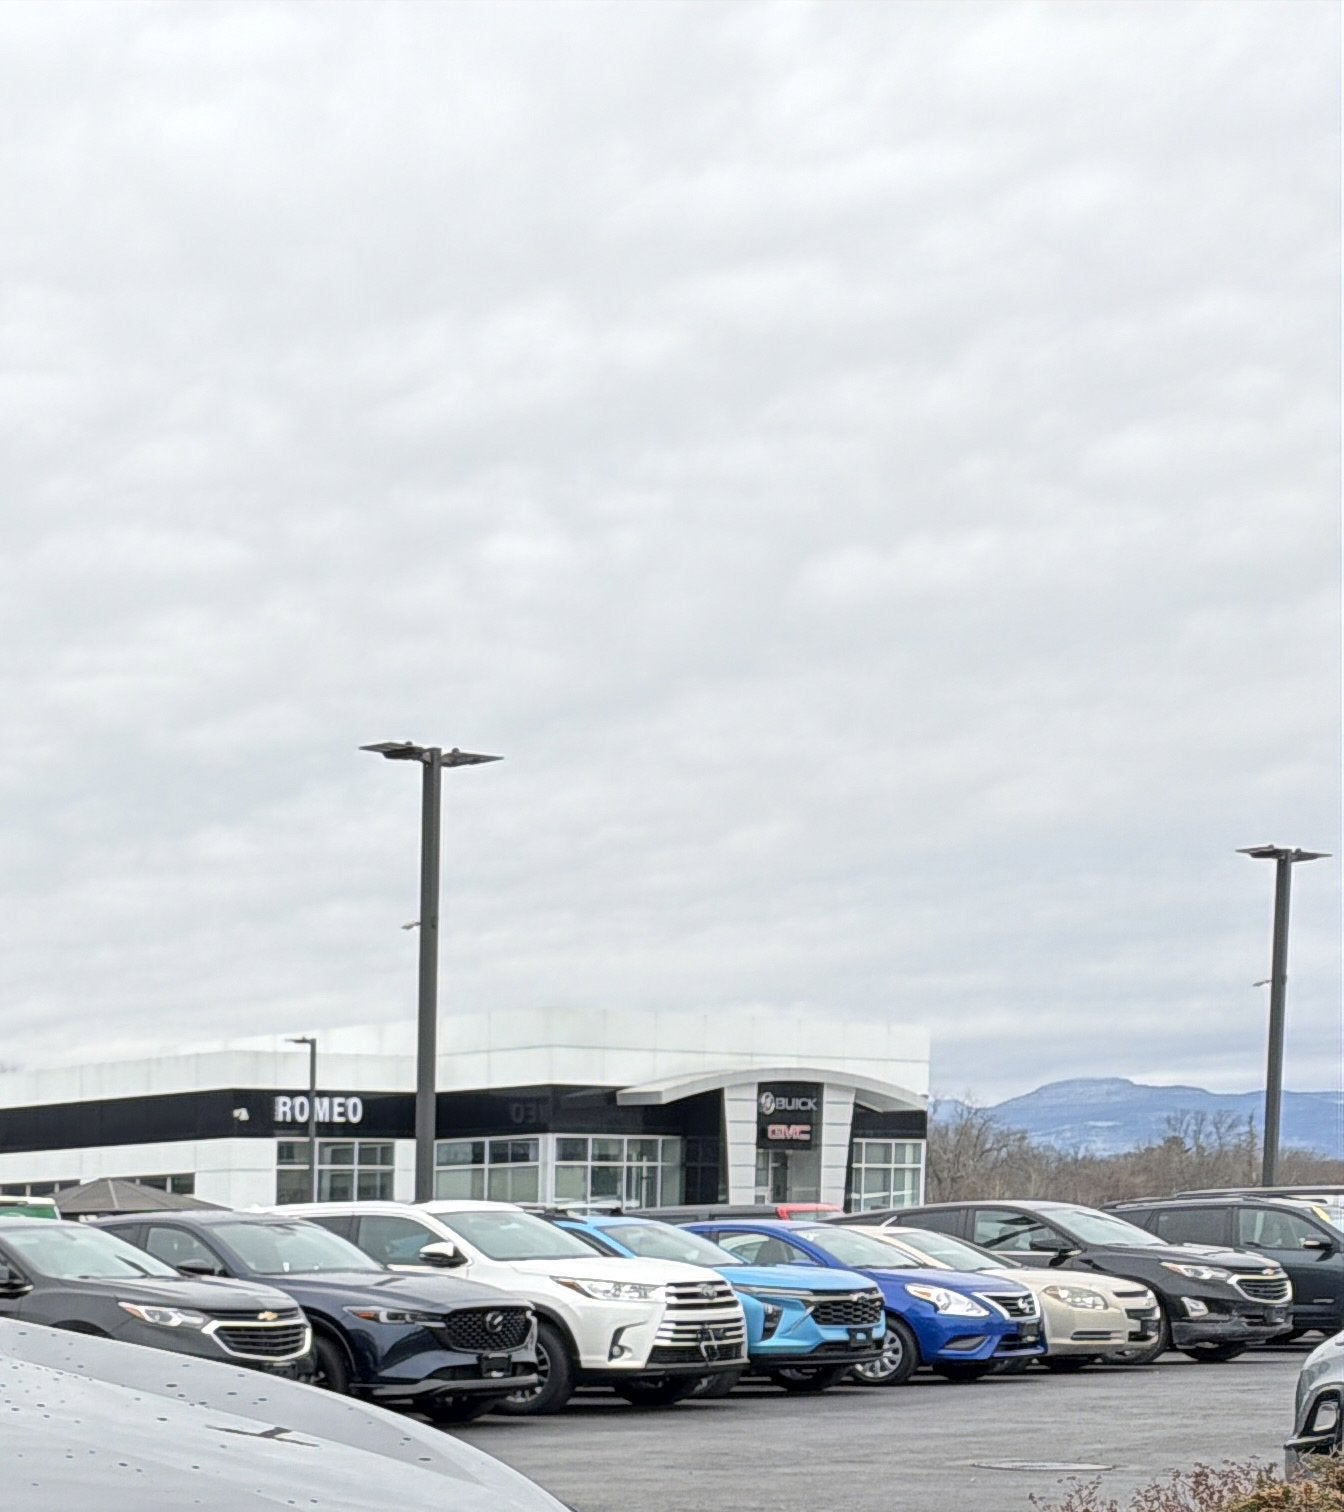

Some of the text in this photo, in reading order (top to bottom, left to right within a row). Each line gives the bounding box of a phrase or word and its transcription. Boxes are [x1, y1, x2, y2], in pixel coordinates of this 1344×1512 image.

[274, 1095, 363, 1124] ROMEO
[775, 1097, 818, 1111] BUICK
[767, 1124, 812, 1140] GMC
